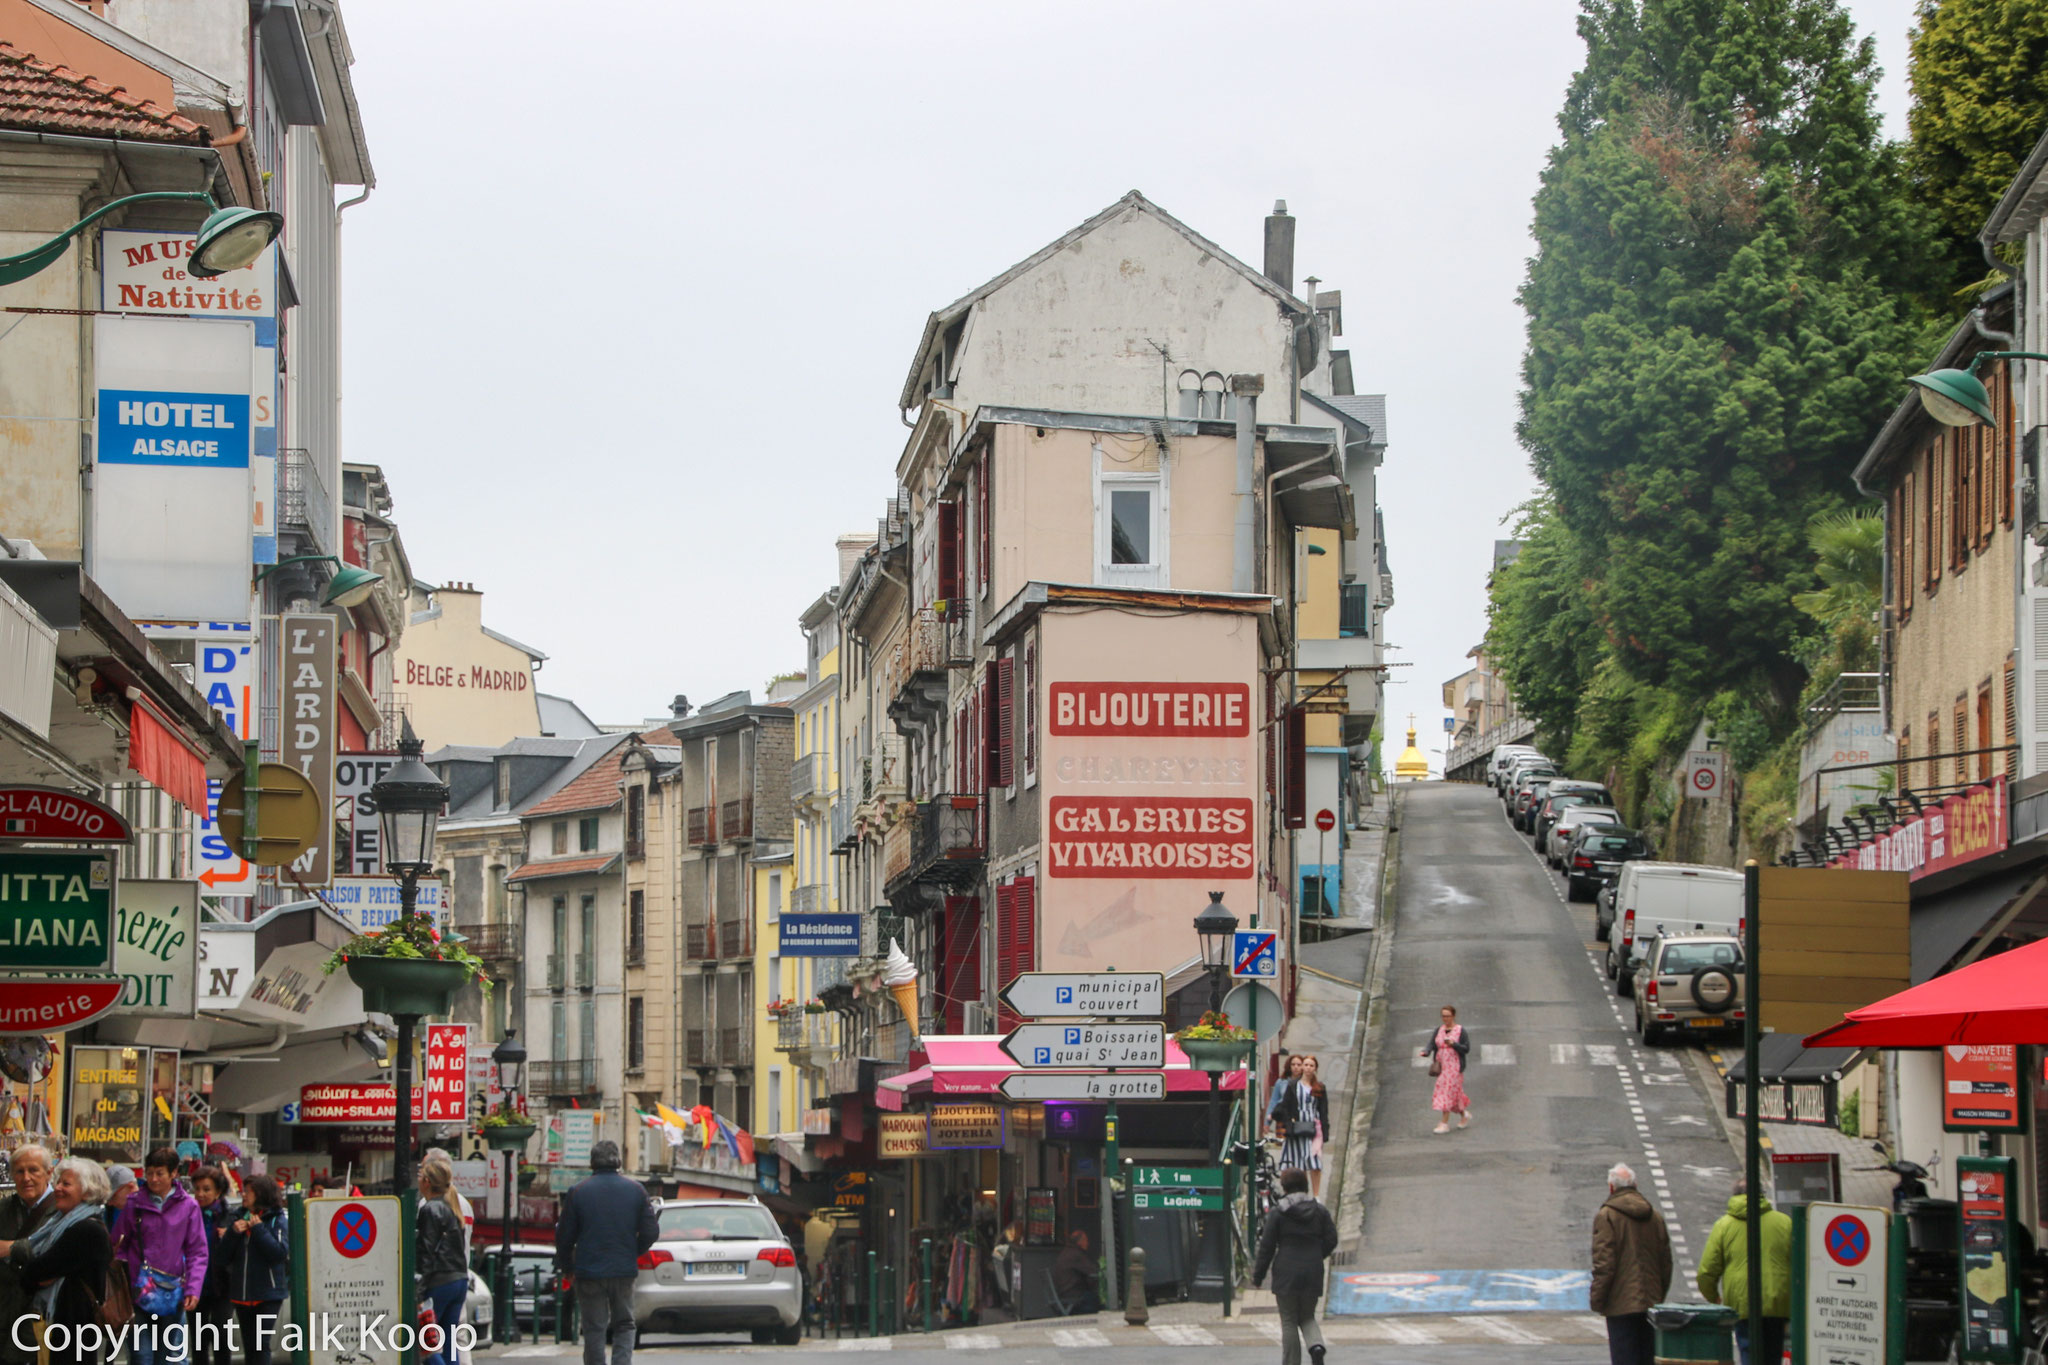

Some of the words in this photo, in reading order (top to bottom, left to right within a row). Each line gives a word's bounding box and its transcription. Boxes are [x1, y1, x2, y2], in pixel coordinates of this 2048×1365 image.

[162, 266, 186, 281] de
[118, 284, 263, 311] Nativité
[118, 400, 235, 429] HOTEL
[132, 438, 219, 458] ALSACE
[407, 659, 453, 687] BELGE
[457, 673, 466, 688] &
[471, 665, 527, 692] MADRID
[1057, 692, 1243, 727] BIJOUTERIE
[1694, 757, 1717, 766] ZONE
[1699, 775, 1711, 784] 30
[1055, 807, 1247, 834] GALERIES
[1951, 790, 1990, 858] GLACES
[1050, 842, 1252, 869] VIVAROISES
[786, 923, 798, 935] La
[799, 922, 853, 935] Résidence
[1261, 962, 1272, 970] 20
[1078, 980, 1158, 995] municipal
[1079, 998, 1139, 1010] couvert
[1084, 1030, 1158, 1044] Boissarie
[1056, 1048, 1090, 1064] quai
[1098, 1048, 1112, 1061] St
[1120, 1048, 1158, 1061] Jean
[1967, 1045, 2013, 1056] NAVETTE
[1087, 1081, 1100, 1093] la
[1109, 1081, 1158, 1096] grotte
[96, 1097, 118, 1112] du
[931, 1104, 1000, 1116] BIJOUTERIE
[931, 1117, 999, 1127] GIOIELLERIA
[75, 1127, 140, 1142] MAGASIN
[1173, 1172, 1179, 1182] 1
[1179, 1174, 1192, 1182] mn
[835, 1194, 865, 1205] ATM
[1163, 1196, 1175, 1206] La
[1175, 1197, 1203, 1206] Grotte
[324, 1280, 346, 1289] ARRÊT
[349, 1280, 385, 1288] AUTOCARS
[339, 1290, 380, 1299] LIVRAISONS
[1841, 1298, 1879, 1310] AUTOCARS
[1820, 1307, 1829, 1317] ET
[1831, 1308, 1874, 1320] LIVRAISONS
